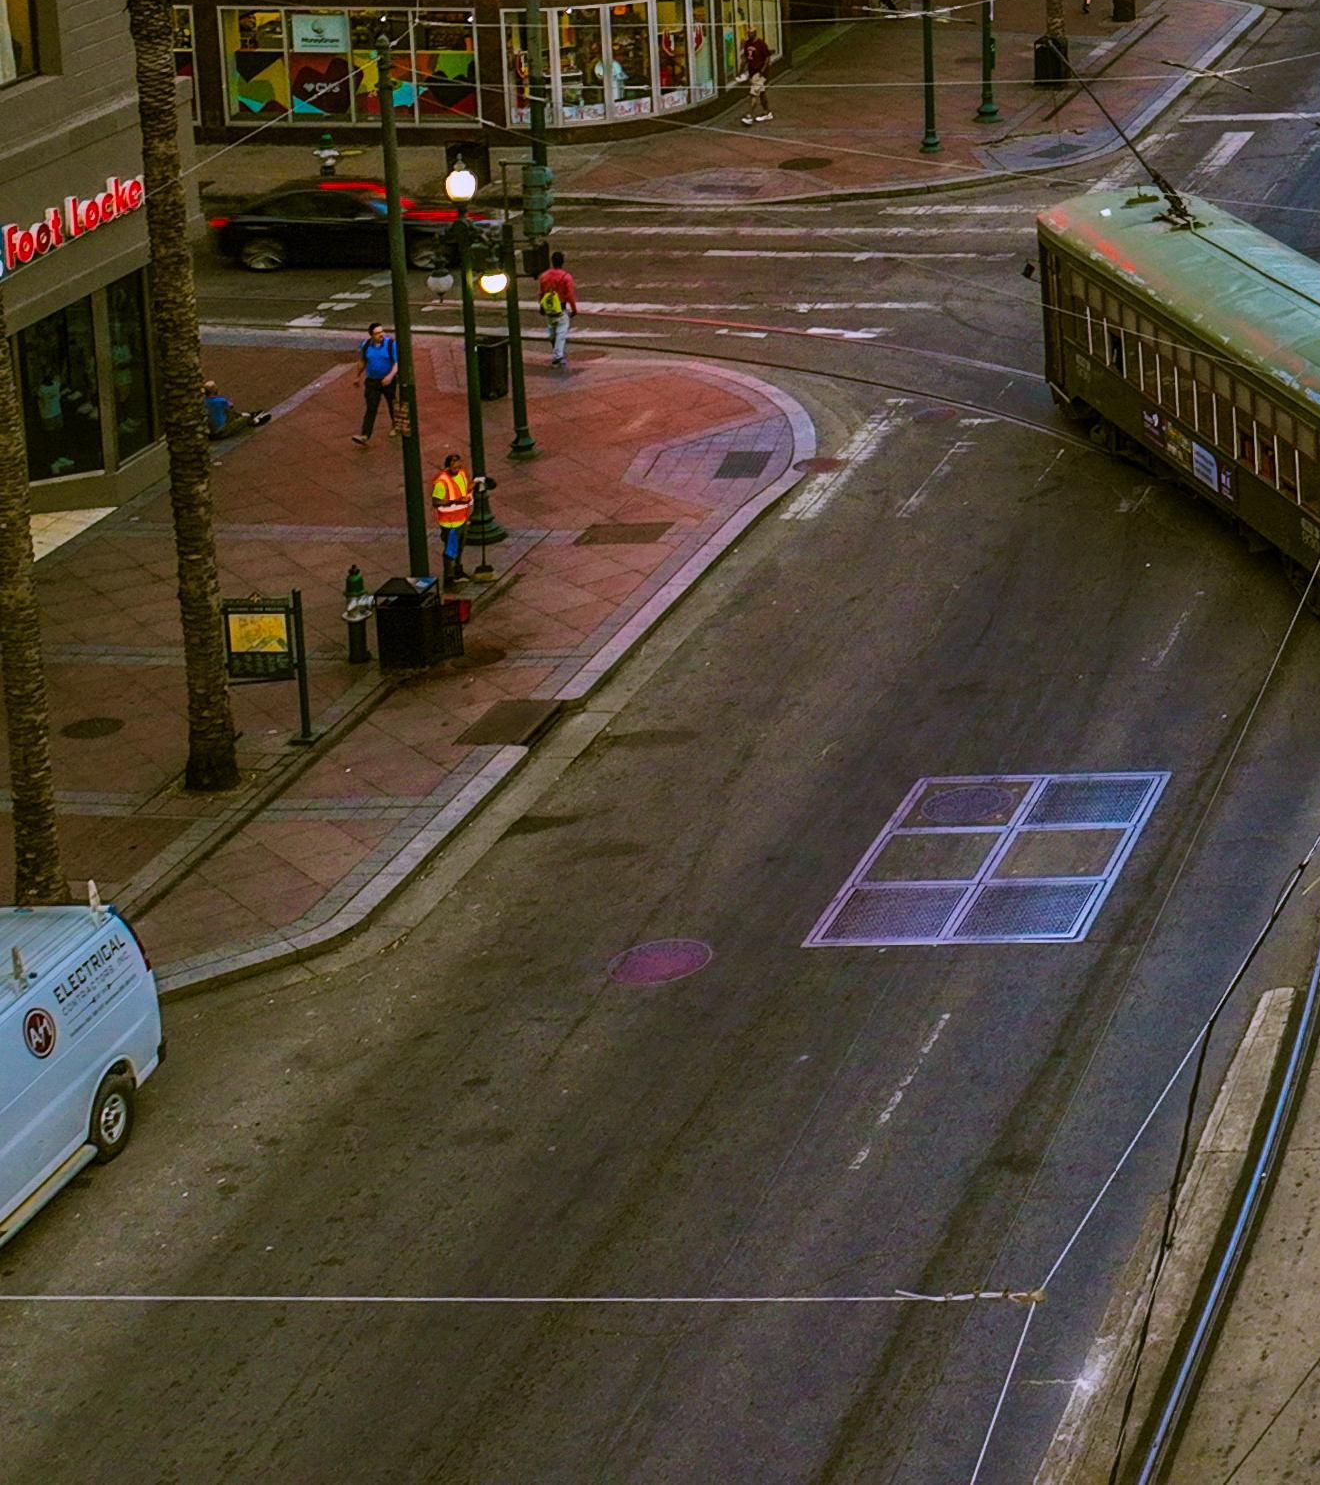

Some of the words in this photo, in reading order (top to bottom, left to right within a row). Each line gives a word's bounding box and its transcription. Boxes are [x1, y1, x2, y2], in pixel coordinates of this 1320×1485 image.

[3, 208, 63, 270] Foot
[53, 935, 126, 1004] ELECTRICAL
[61, 965, 115, 1016] CONTRACTORS
